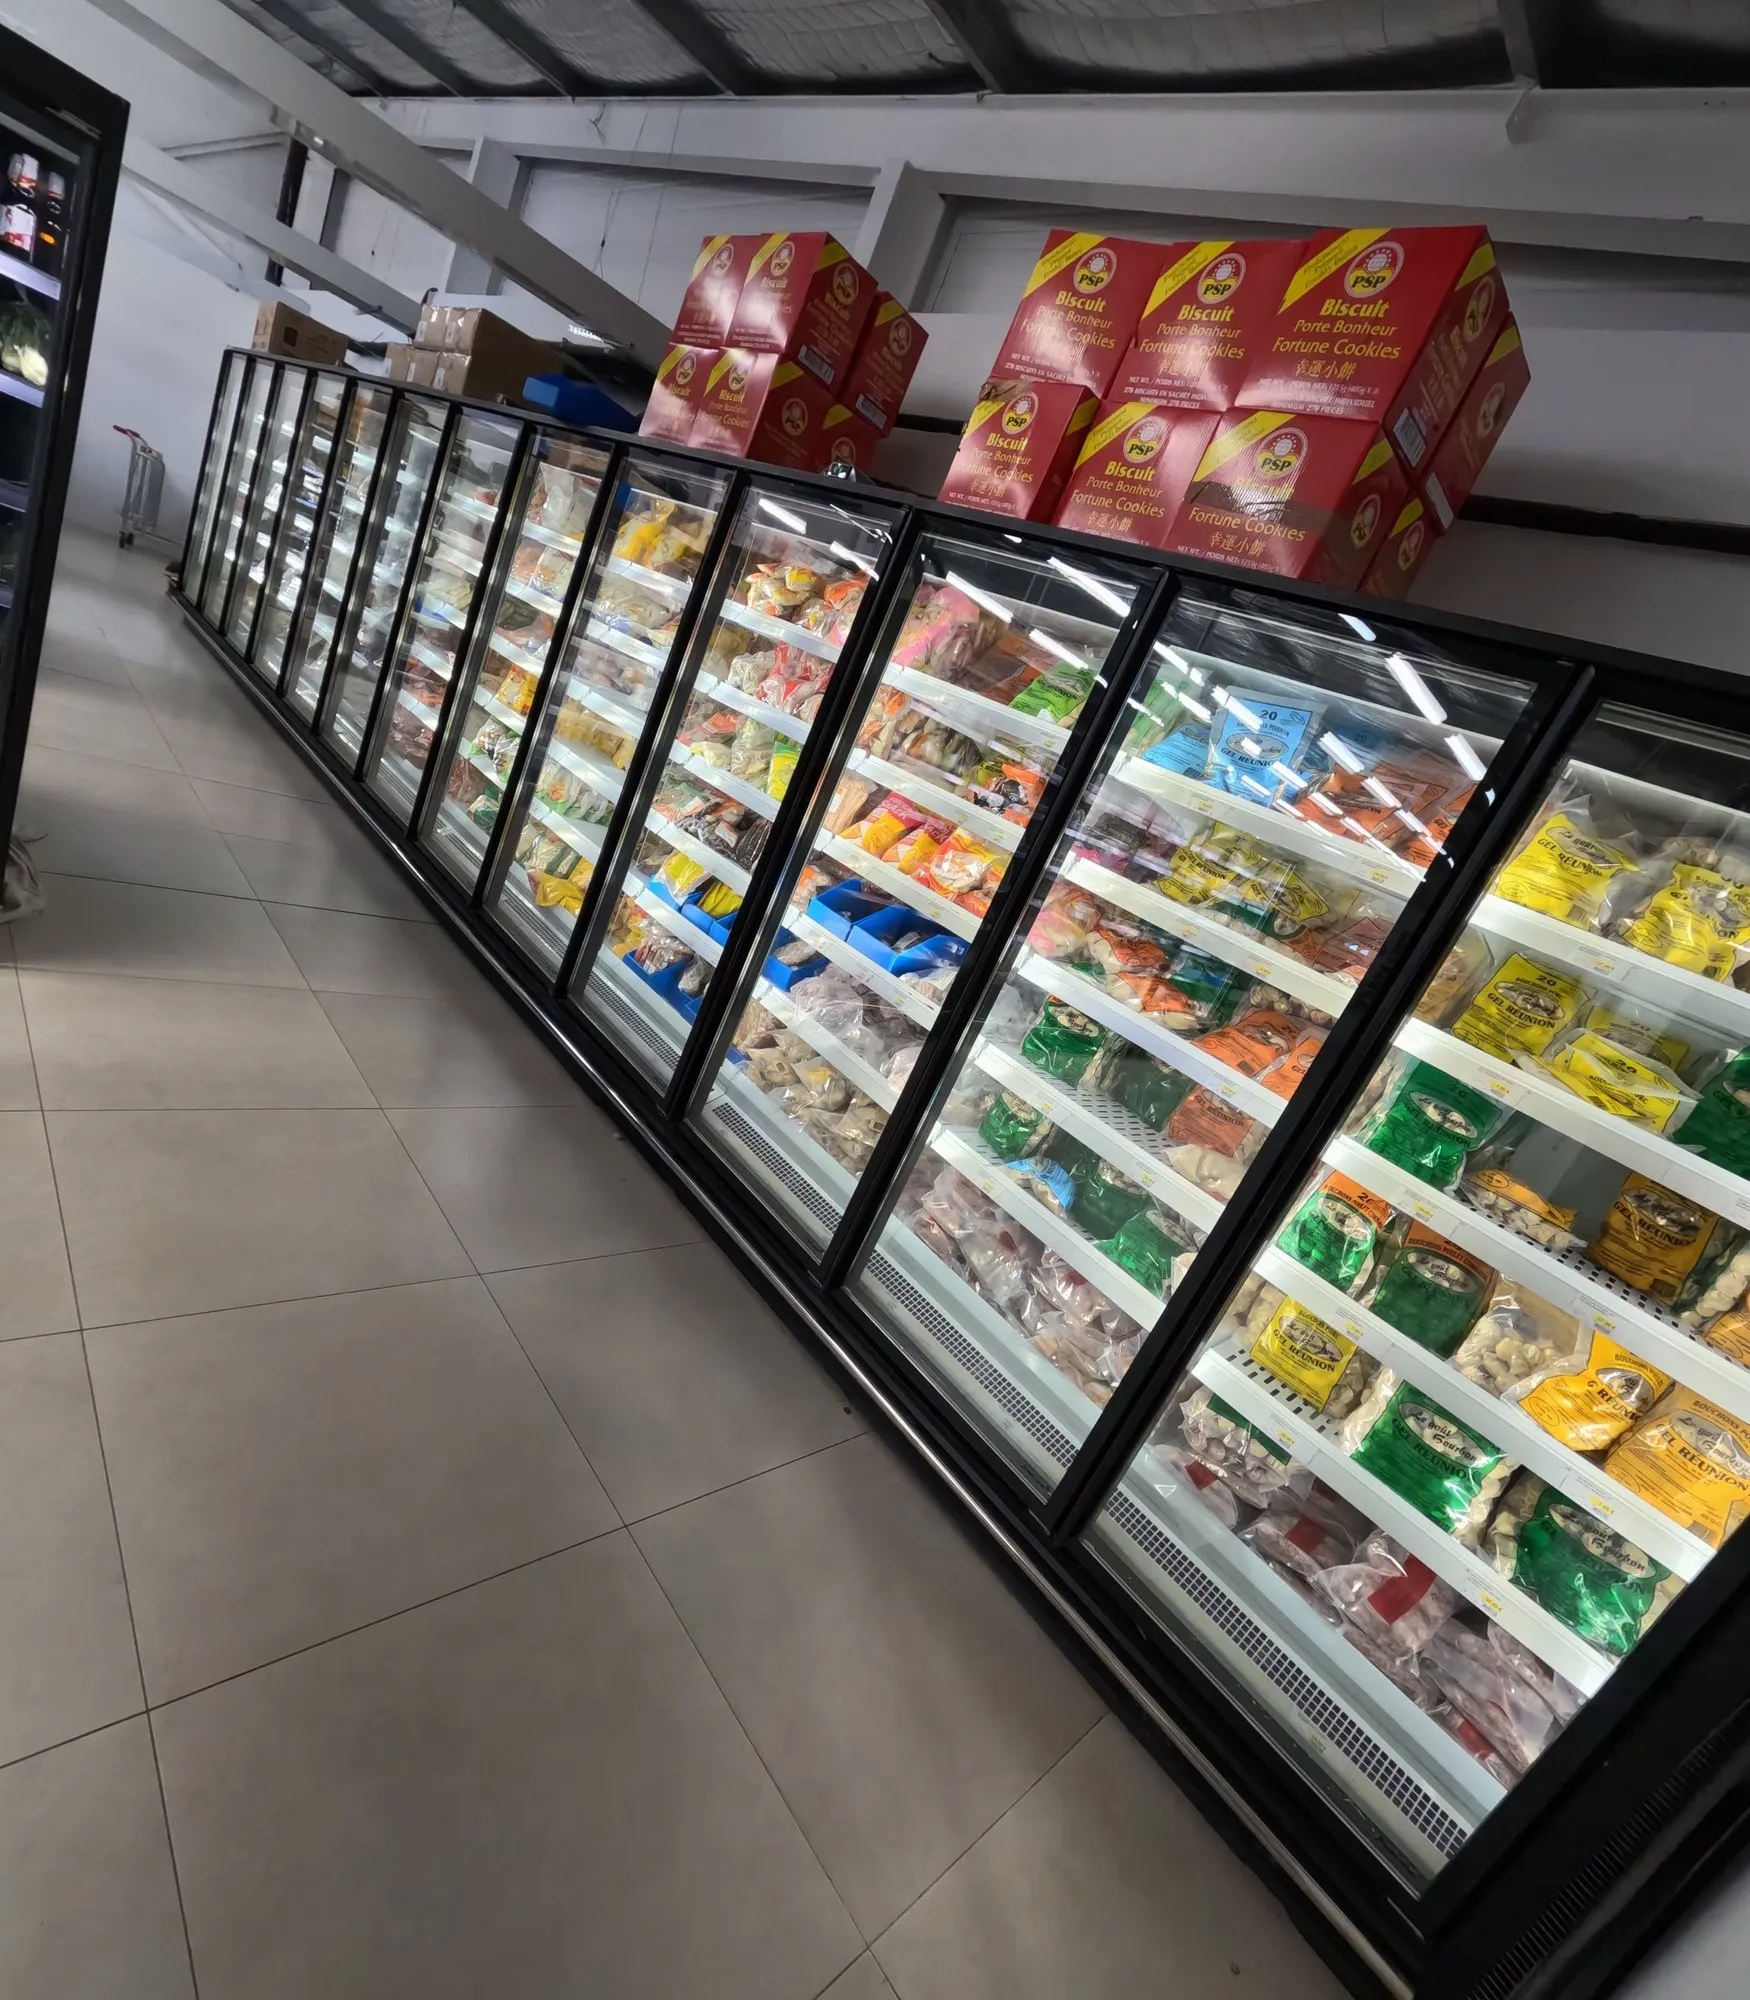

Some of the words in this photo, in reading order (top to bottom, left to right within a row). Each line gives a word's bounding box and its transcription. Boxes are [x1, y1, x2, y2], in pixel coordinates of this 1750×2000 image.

[1078, 273, 1105, 288] PSP
[1203, 284, 1232, 296] PSP
[1351, 275, 1386, 289] PSP
[1056, 290, 1107, 312] Biscuit
[1319, 299, 1389, 318] Biscuit
[1037, 305, 1063, 320] Porte
[1066, 310, 1113, 329] Bonheur
[1177, 304, 1235, 322] Biscuit
[1066, 326, 1116, 349] Cookies
[1157, 323, 1187, 335] Porte
[1190, 324, 1241, 339] Bonheur
[1293, 320, 1331, 333] Porte
[1333, 320, 1397, 337] Bonheur
[1139, 338, 1186, 354] Fortune
[1190, 340, 1245, 359] Cookies
[1272, 337, 1329, 354] Fortune
[1333, 339, 1401, 359] Cookies
[719, 389, 745, 403] Biscuit
[1006, 416, 1027, 428] PSP
[986, 432, 1028, 451] Biscuit
[1128, 443, 1154, 456] PSP
[973, 447, 993, 459] Porte
[994, 451, 1032, 465] Bonheur
[1261, 457, 1292, 472] PSP
[994, 465, 1034, 483] Cookies
[1105, 461, 1156, 482] Biscuit
[1086, 476, 1114, 490] Porte
[1115, 480, 1162, 498] Bonheur
[1070, 489, 1112, 508] Fortune
[1115, 497, 1165, 518] Cookies
[1188, 506, 1241, 529] Fortune
[1245, 517, 1307, 542] Cookies
[1260, 709, 1278, 721] 20
[1221, 747, 1236, 758] GEL
[1238, 755, 1276, 767] REUNIO
[1537, 838, 1556, 852] GEL
[1558, 853, 1603, 877] REUNION
[1196, 860, 1227, 880] REUNION
[1536, 974, 1557, 987] 20
[1487, 992, 1505, 1008] GEL
[1505, 1005, 1555, 1029] REUNION
[1423, 1118, 1471, 1148] REUNION
[1273, 1329, 1288, 1347] GEL
[1289, 1344, 1336, 1373] REUNION
[1411, 1410, 1427, 1423] Le
[1427, 1421, 1452, 1437] goût
[1693, 1400, 1739, 1430] BOUCHONS
[1391, 1417, 1410, 1441] GEL
[1432, 1433, 1477, 1462] Bourbon
[1655, 1423, 1676, 1447] GEL
[1678, 1446, 1748, 1491] REUNION
